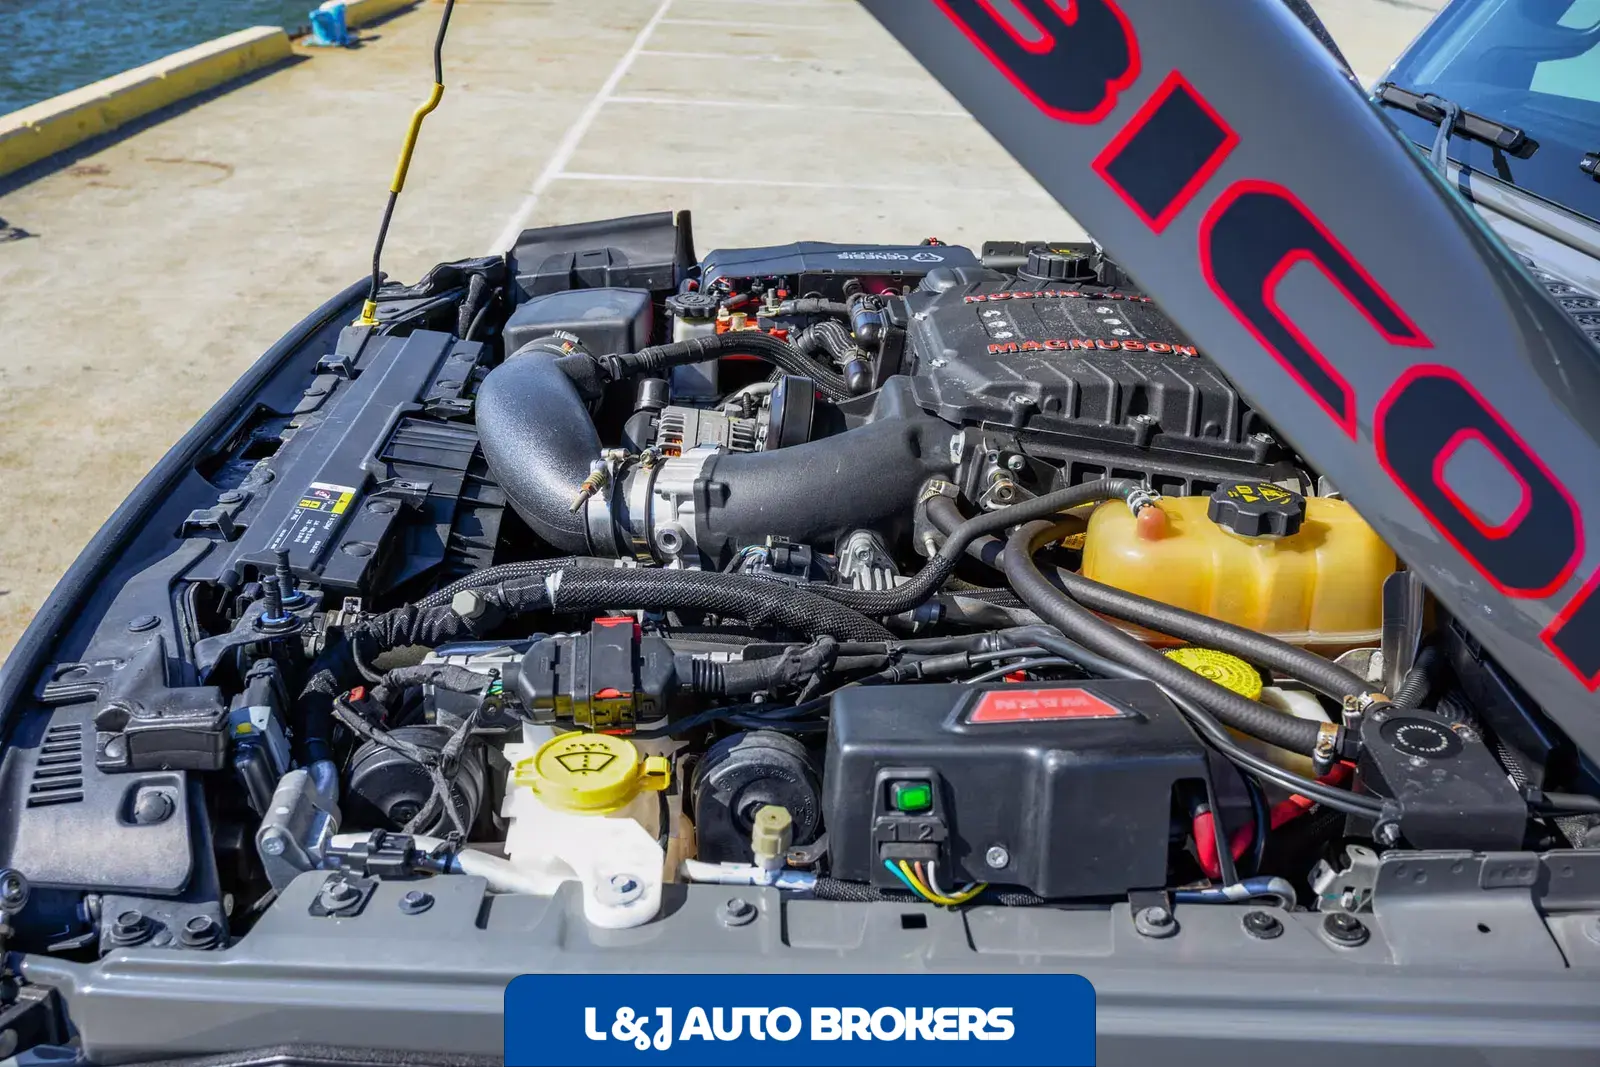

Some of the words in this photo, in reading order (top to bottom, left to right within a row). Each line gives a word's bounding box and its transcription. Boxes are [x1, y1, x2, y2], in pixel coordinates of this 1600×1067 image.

[837, 253, 909, 261] GENESIS
[987, 338, 1200, 357] MAGNUSON
[887, 822, 899, 841] 1
[918, 822, 934, 840] 2
